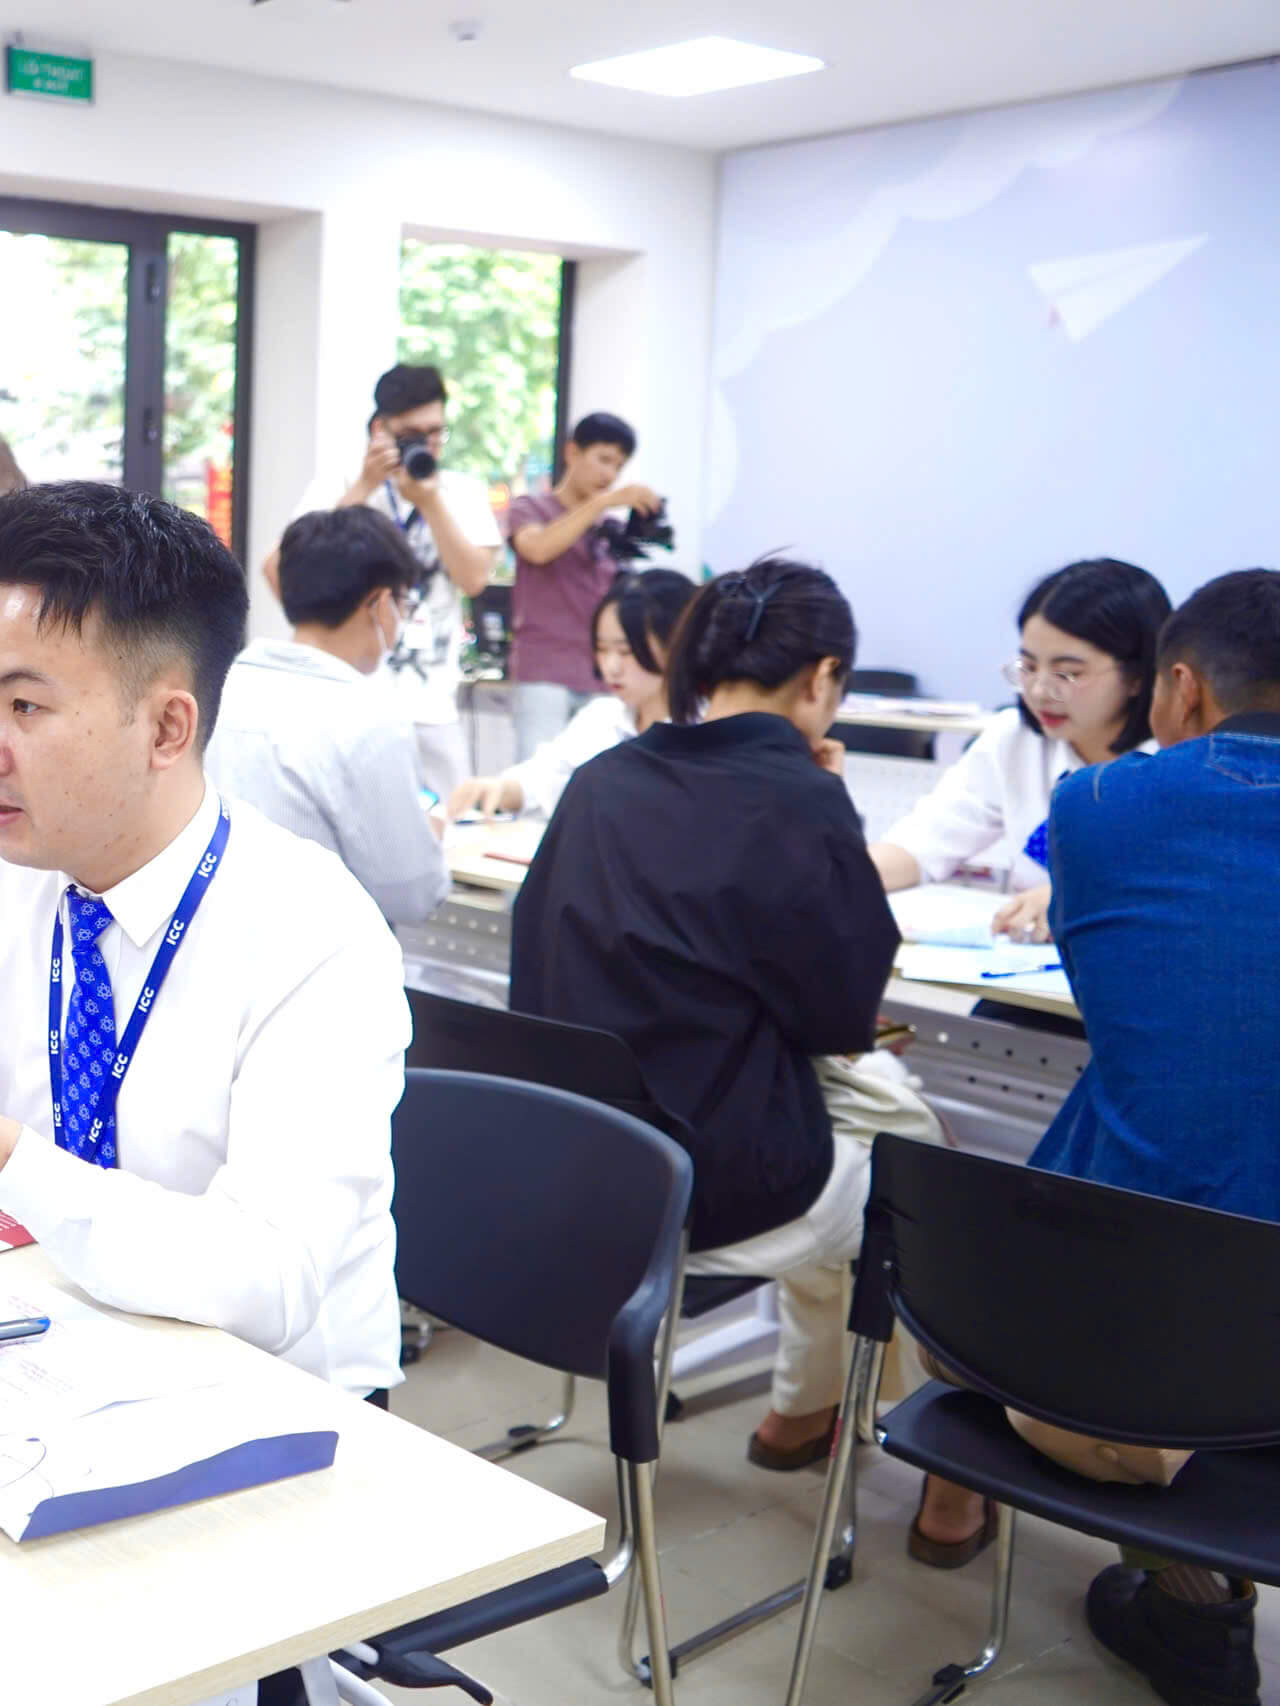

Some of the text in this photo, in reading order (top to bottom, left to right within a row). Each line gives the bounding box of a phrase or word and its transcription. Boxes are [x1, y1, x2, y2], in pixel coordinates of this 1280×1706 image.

[50, 957, 62, 1127] ICC ICC ICC
[88, 853, 217, 1143] ICC ICC ICC ICC ICC
